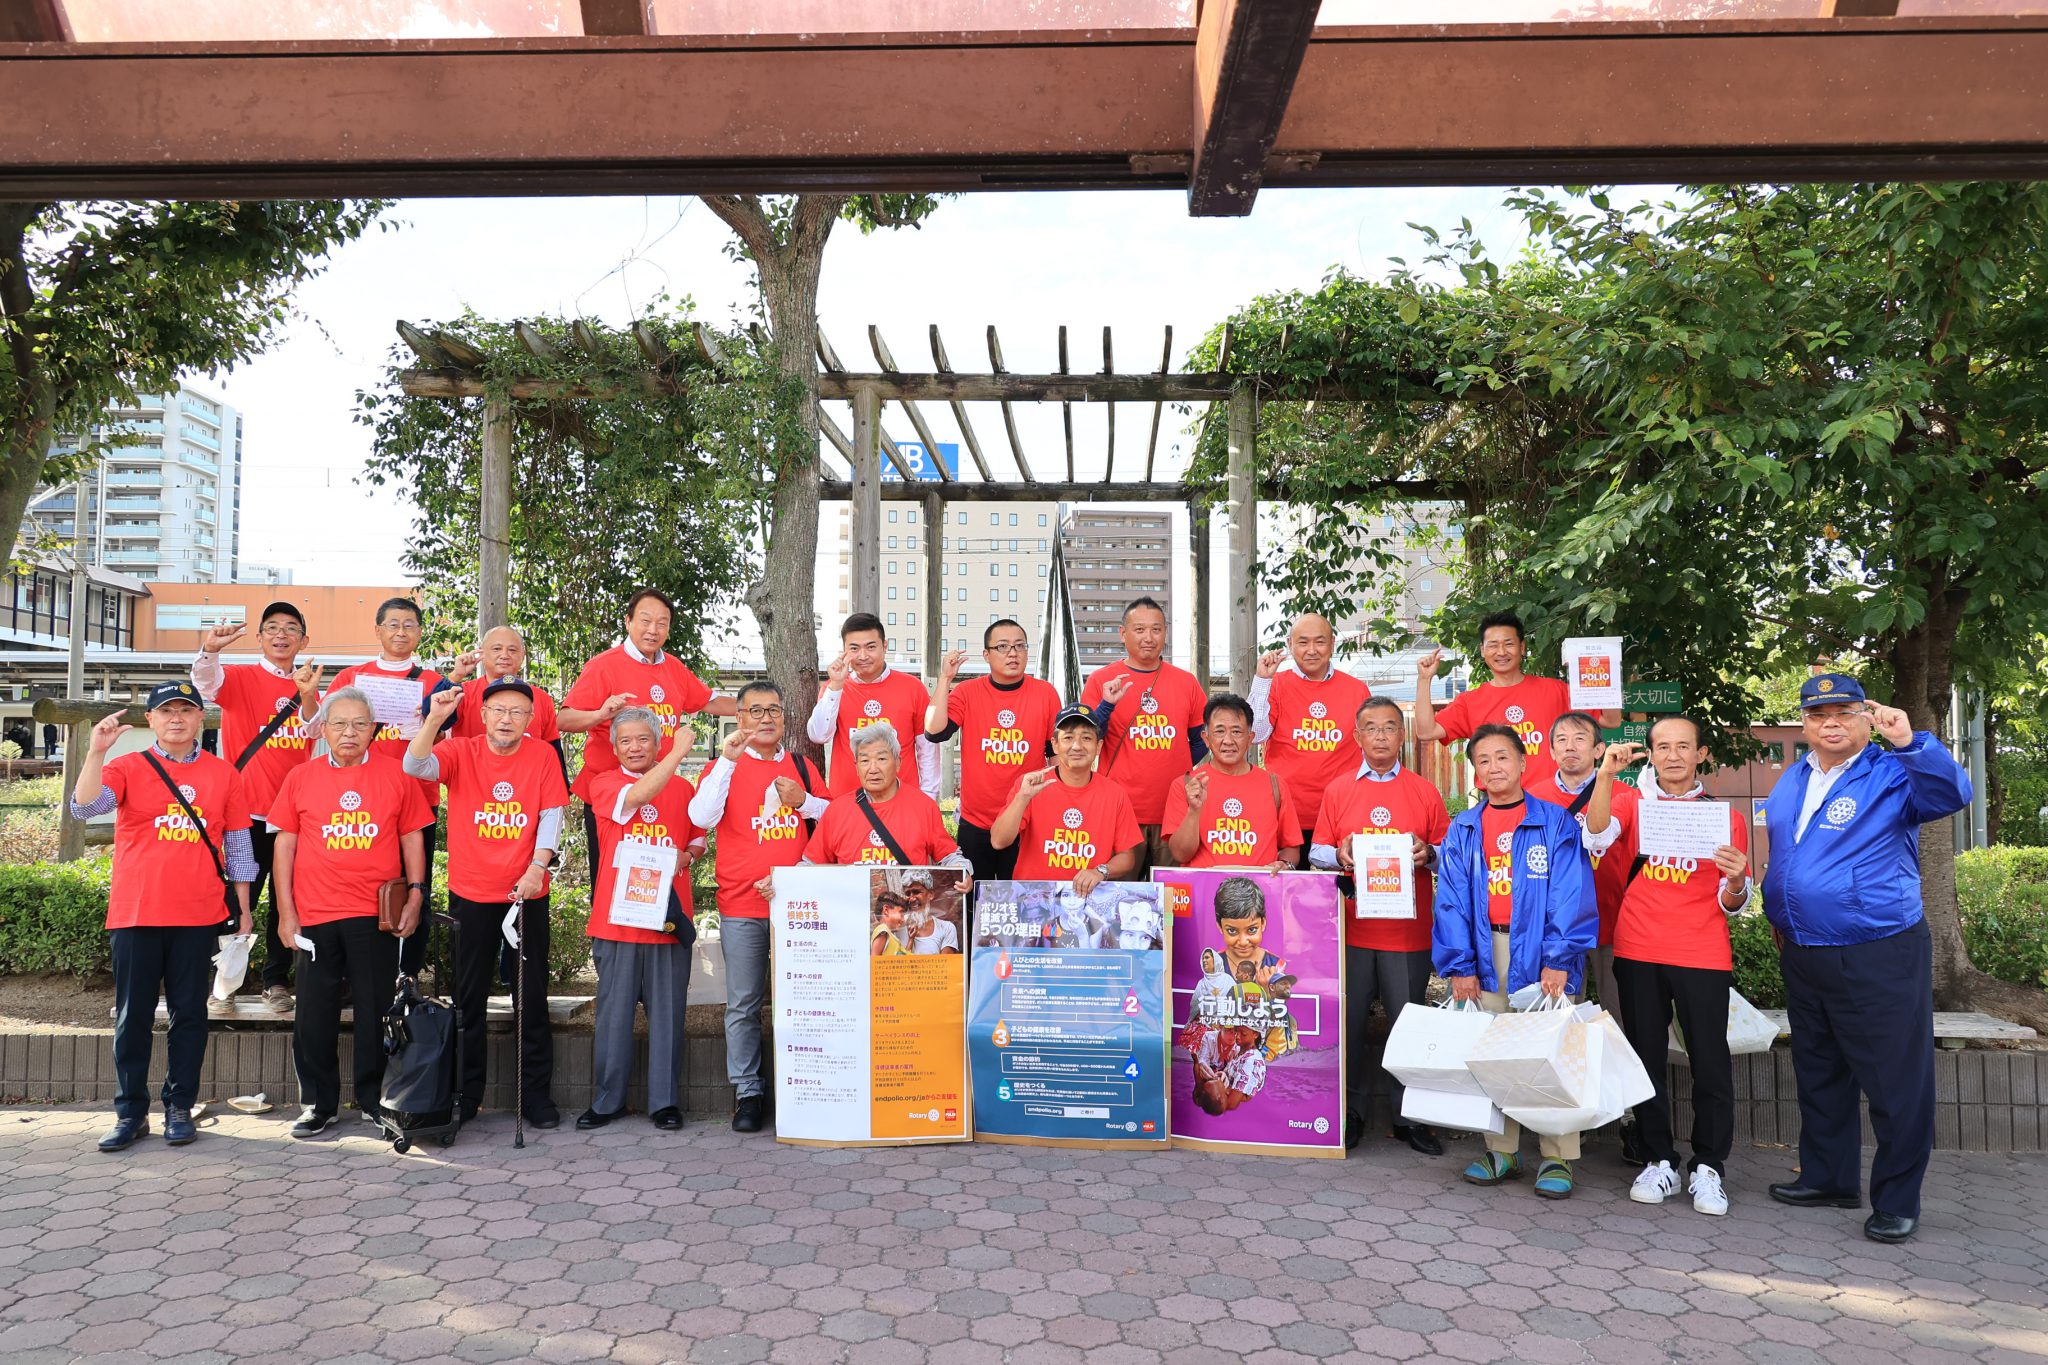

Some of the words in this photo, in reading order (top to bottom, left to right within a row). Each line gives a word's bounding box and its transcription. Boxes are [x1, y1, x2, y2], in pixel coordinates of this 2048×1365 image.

[1581, 673, 1610, 681] POLIO
[1136, 714, 1168, 727] END
[1301, 718, 1336, 731] END
[259, 725, 309, 739] OLIO
[375, 727, 401, 741] NO
[989, 727, 1023, 741] END
[1129, 725, 1176, 739] POLIO
[1511, 721, 1535, 735] ND
[1293, 729, 1343, 742] POLIO
[265, 736, 306, 750] NOW
[981, 738, 1029, 753] POLIO
[1135, 736, 1172, 750] NOW
[1297, 739, 1338, 752] NOW
[985, 751, 1024, 765] NOW
[484, 801, 522, 815] END
[331, 811, 371, 826] END
[474, 811, 528, 827] POLIO
[751, 814, 799, 830] POLIO
[1216, 817, 1251, 832] END
[158, 827, 201, 844] NOW
[322, 823, 379, 838] POLIO
[478, 824, 523, 840] NOW
[631, 823, 668, 837] END
[758, 826, 797, 841] NOW
[1053, 828, 1090, 844] END
[1207, 829, 1257, 844] POLIO
[327, 836, 373, 850] NOW
[623, 833, 673, 847] POLIO
[1044, 839, 1096, 858] POLIO
[1212, 841, 1253, 856] NOW
[1048, 852, 1091, 869] NOW
[1490, 853, 1512, 871] EN
[1648, 854, 1698, 872] OLIO
[1369, 876, 1400, 885] POLIO
[1487, 867, 1513, 882] POL
[1642, 863, 1692, 884] NOW
[627, 885, 657, 897] POLIO
[634, 880, 654, 888] END
[1488, 880, 1512, 896] NO
[630, 893, 653, 902] NOW
[1173, 889, 1187, 897] ND
[787, 900, 819, 910] ポリオを
[981, 902, 1018, 913] ポリオを
[1173, 903, 1188, 911] OW
[788, 921, 828, 931] 5つの理由
[980, 922, 1042, 938] 5つの理由
[999, 960, 1007, 977] 1
[1125, 996, 1138, 1012] 2
[1197, 995, 1288, 1019] 行動しよう
[994, 1028, 1007, 1045] 3
[1125, 1063, 1139, 1077] 4
[999, 1086, 1011, 1100] 5
[909, 1112, 929, 1120] Rotary
[1288, 1120, 1313, 1130] Rotary
